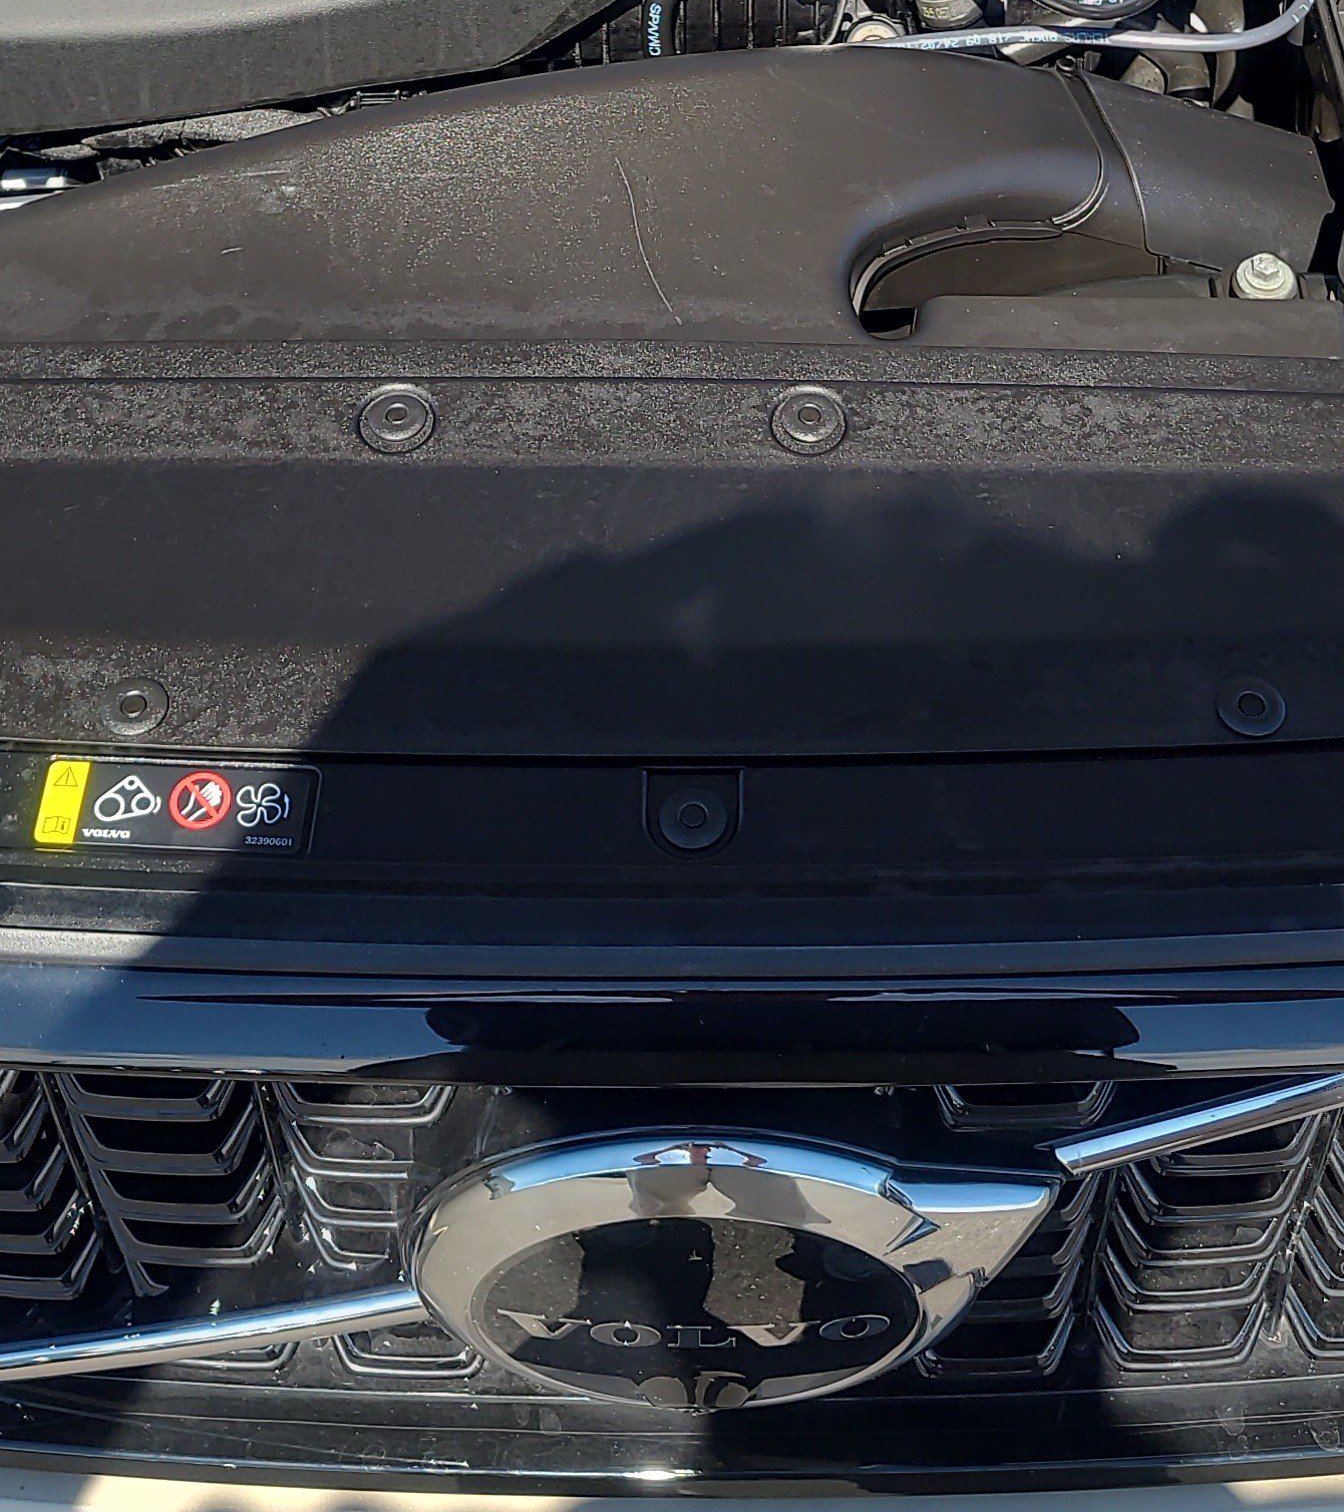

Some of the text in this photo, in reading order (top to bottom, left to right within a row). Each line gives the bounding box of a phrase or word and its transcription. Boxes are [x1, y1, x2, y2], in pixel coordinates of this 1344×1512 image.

[82, 828, 131, 839] VOLVO
[244, 835, 293, 847] 32390601
[498, 1308, 891, 1349] VOLVO
